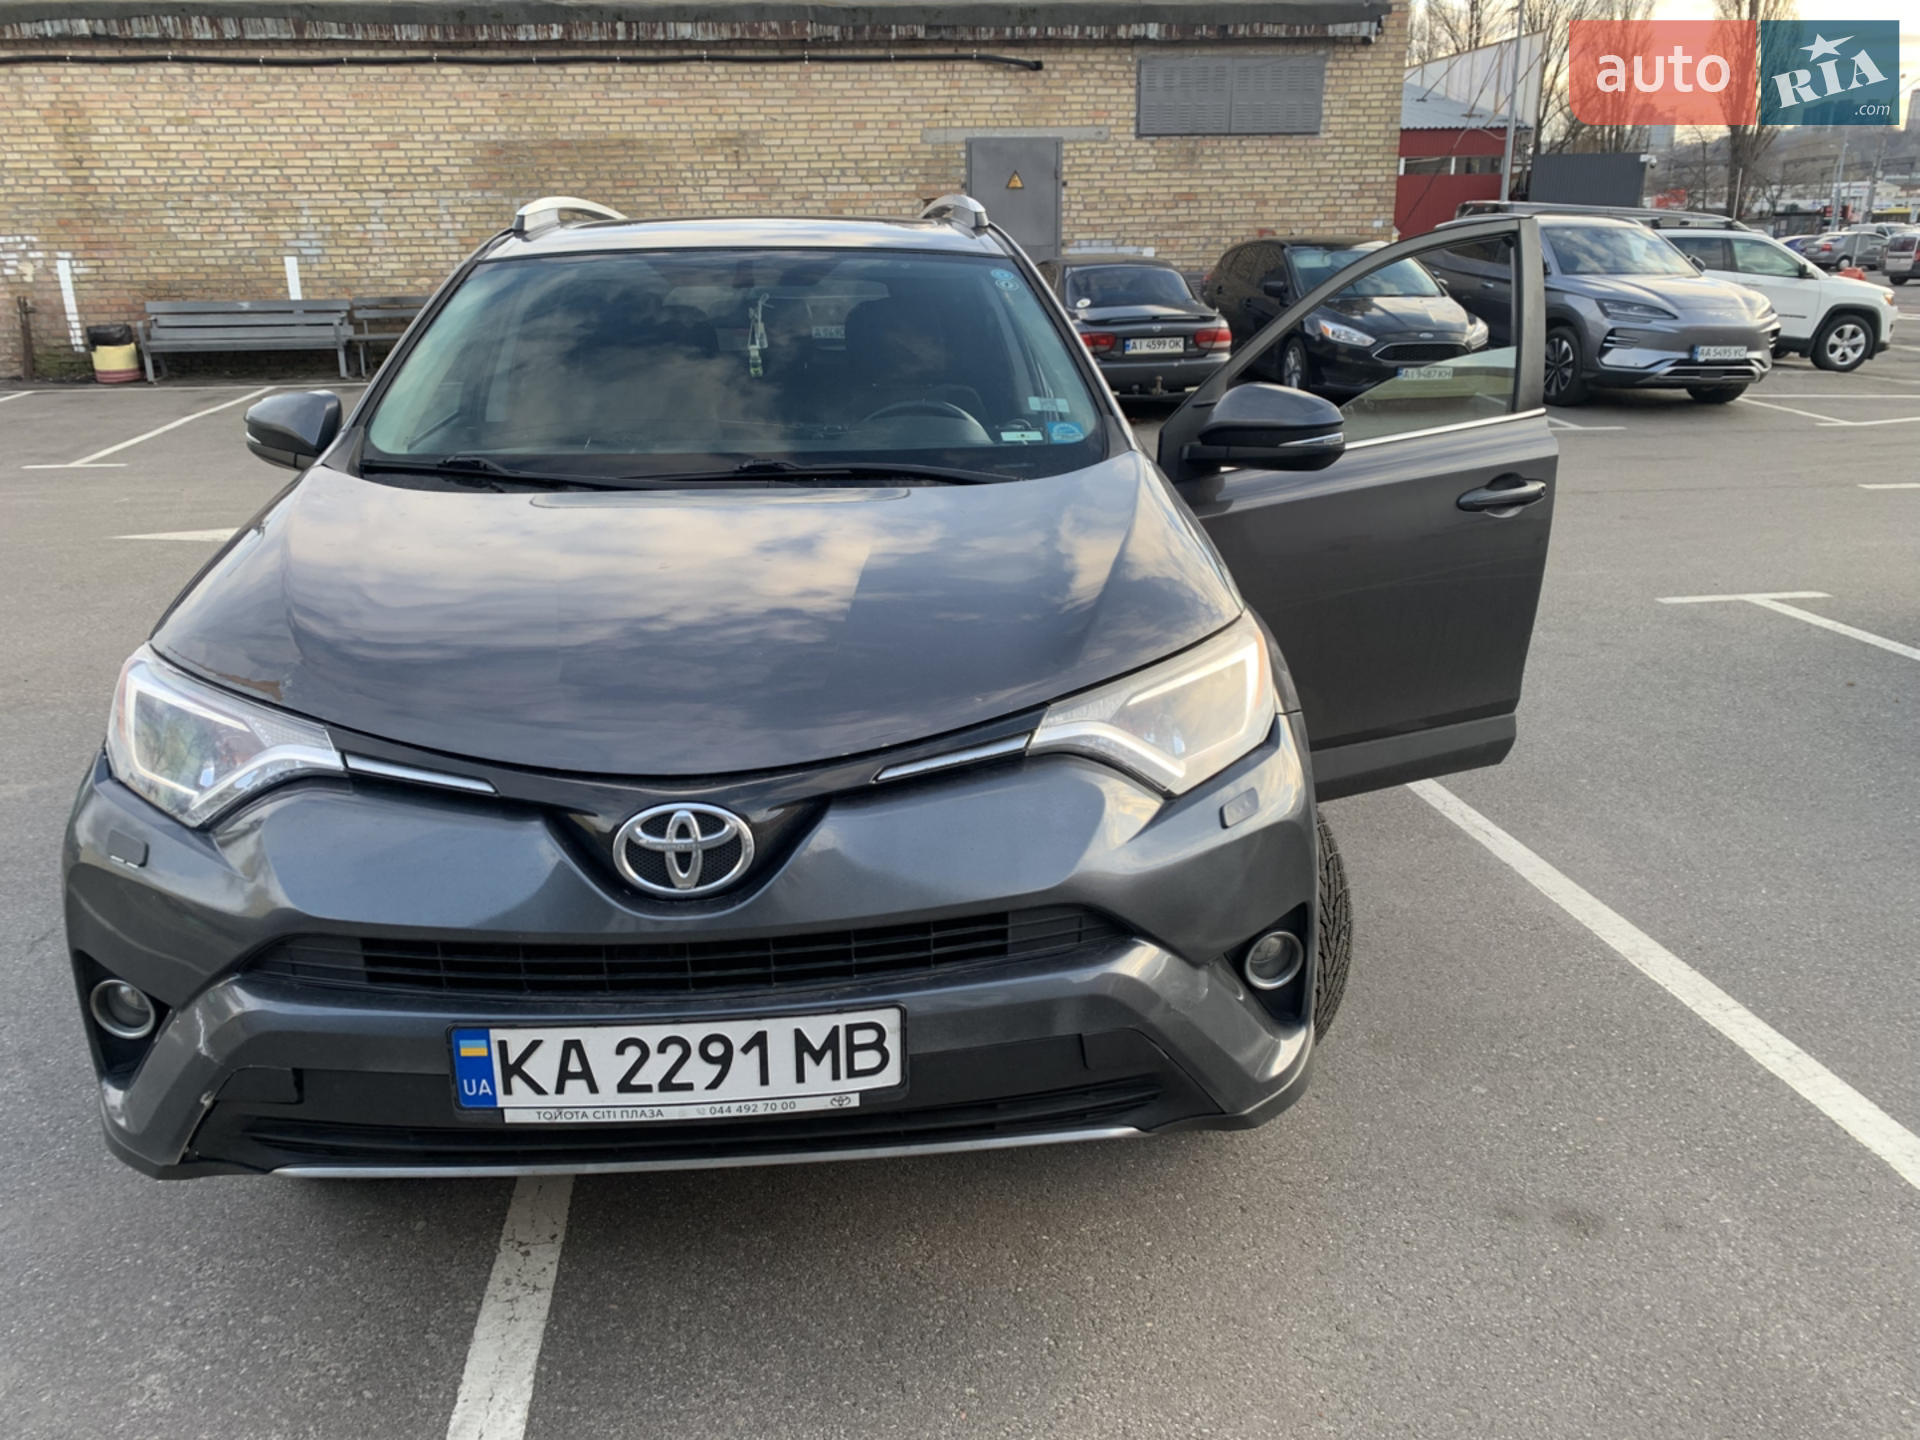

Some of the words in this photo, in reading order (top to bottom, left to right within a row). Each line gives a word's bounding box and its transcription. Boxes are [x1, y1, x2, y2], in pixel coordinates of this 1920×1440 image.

[1146, 340, 1167, 350] 4599
[1168, 339, 1182, 349] OK
[497, 1039, 600, 1096] KA
[615, 1030, 770, 1094] 2291
[794, 1021, 890, 1084] MB
[463, 1079, 493, 1096] UA
[536, 1109, 589, 1121] ТОЙОТА
[620, 1108, 665, 1119] ПЛАЗА
[709, 1105, 732, 1116] 044
[735, 1104, 758, 1114] 492
[763, 1102, 777, 1112] 70
[781, 1101, 796, 1110] 00
